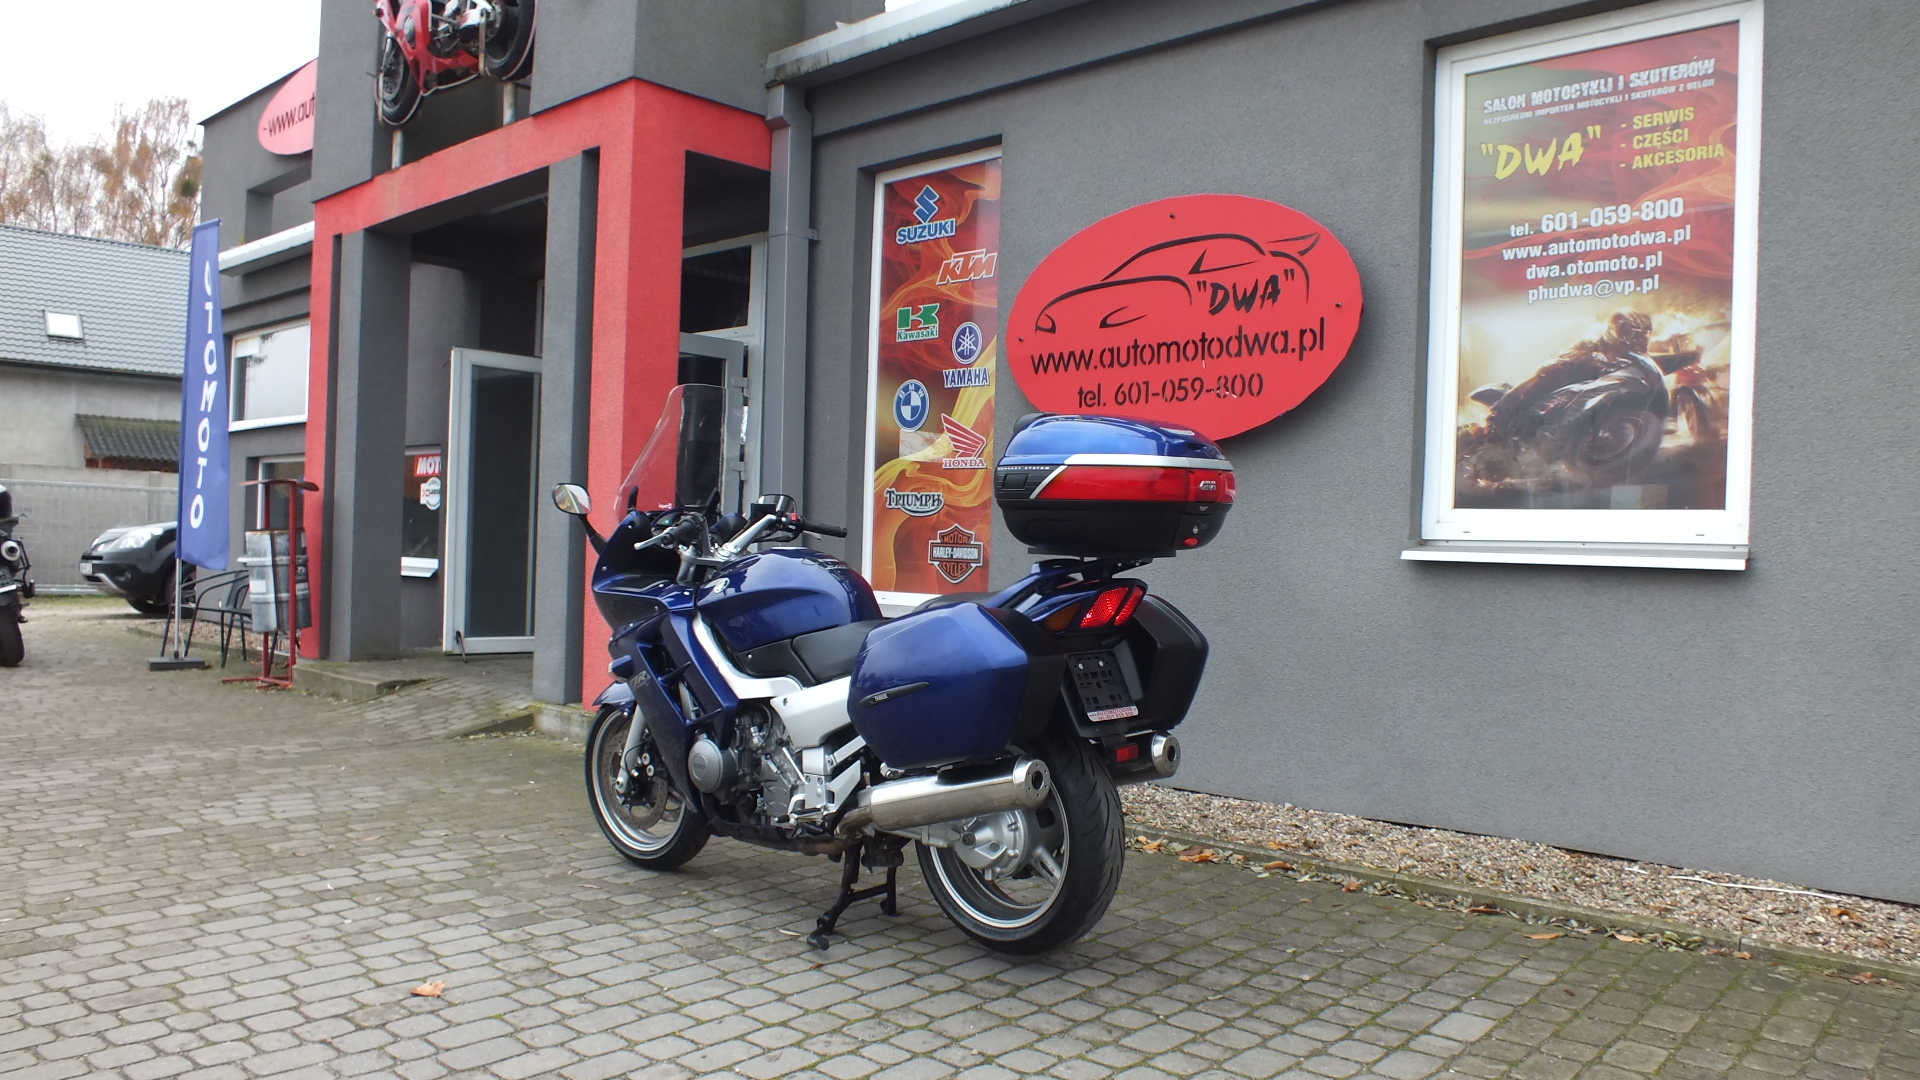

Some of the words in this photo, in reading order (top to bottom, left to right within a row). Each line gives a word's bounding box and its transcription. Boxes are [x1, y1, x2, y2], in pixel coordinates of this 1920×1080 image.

[1483, 94, 1526, 114] SALON
[1530, 76, 1613, 107] MOTOCYKLI
[1618, 75, 1625, 91] I
[1629, 55, 1716, 88] SKUTERÓW
[1534, 103, 1575, 117] IMPORTER
[1576, 95, 1623, 110] MOTOCYKLI
[1632, 107, 1695, 129] SERWIS
[1632, 126, 1690, 150] CZĘŚCI
[1480, 124, 1602, 180] "DWA"
[1632, 142, 1726, 170] AKCESORIA
[1509, 222, 1534, 237] tel.
[1541, 196, 1684, 234] 601-059-800
[896, 218, 956, 244] SUZUKI
[1502, 224, 1692, 261] www.automotodwa.pl
[936, 249, 998, 285] KTM
[1526, 250, 1663, 280] dwa.otomoto.pl
[1196, 268, 1296, 316] "DWA"
[1527, 274, 1660, 305] phudwa@vp.pl
[897, 329, 939, 341] Kawasaki
[1030, 316, 1326, 375] www.automotodwa.pl
[943, 367, 990, 387] YAMAHA
[1077, 383, 1107, 408] tel.
[1114, 371, 1265, 406] 601-059-800
[898, 383, 926, 398] BMW
[416, 455, 442, 475] MOT
[942, 458, 985, 468] HONDA
[884, 489, 944, 507] TRIUMPH
[943, 531, 969, 544] MOTOR
[932, 546, 979, 560] HARLEY-DAVIDSON
[942, 561, 968, 577] CYCLES
